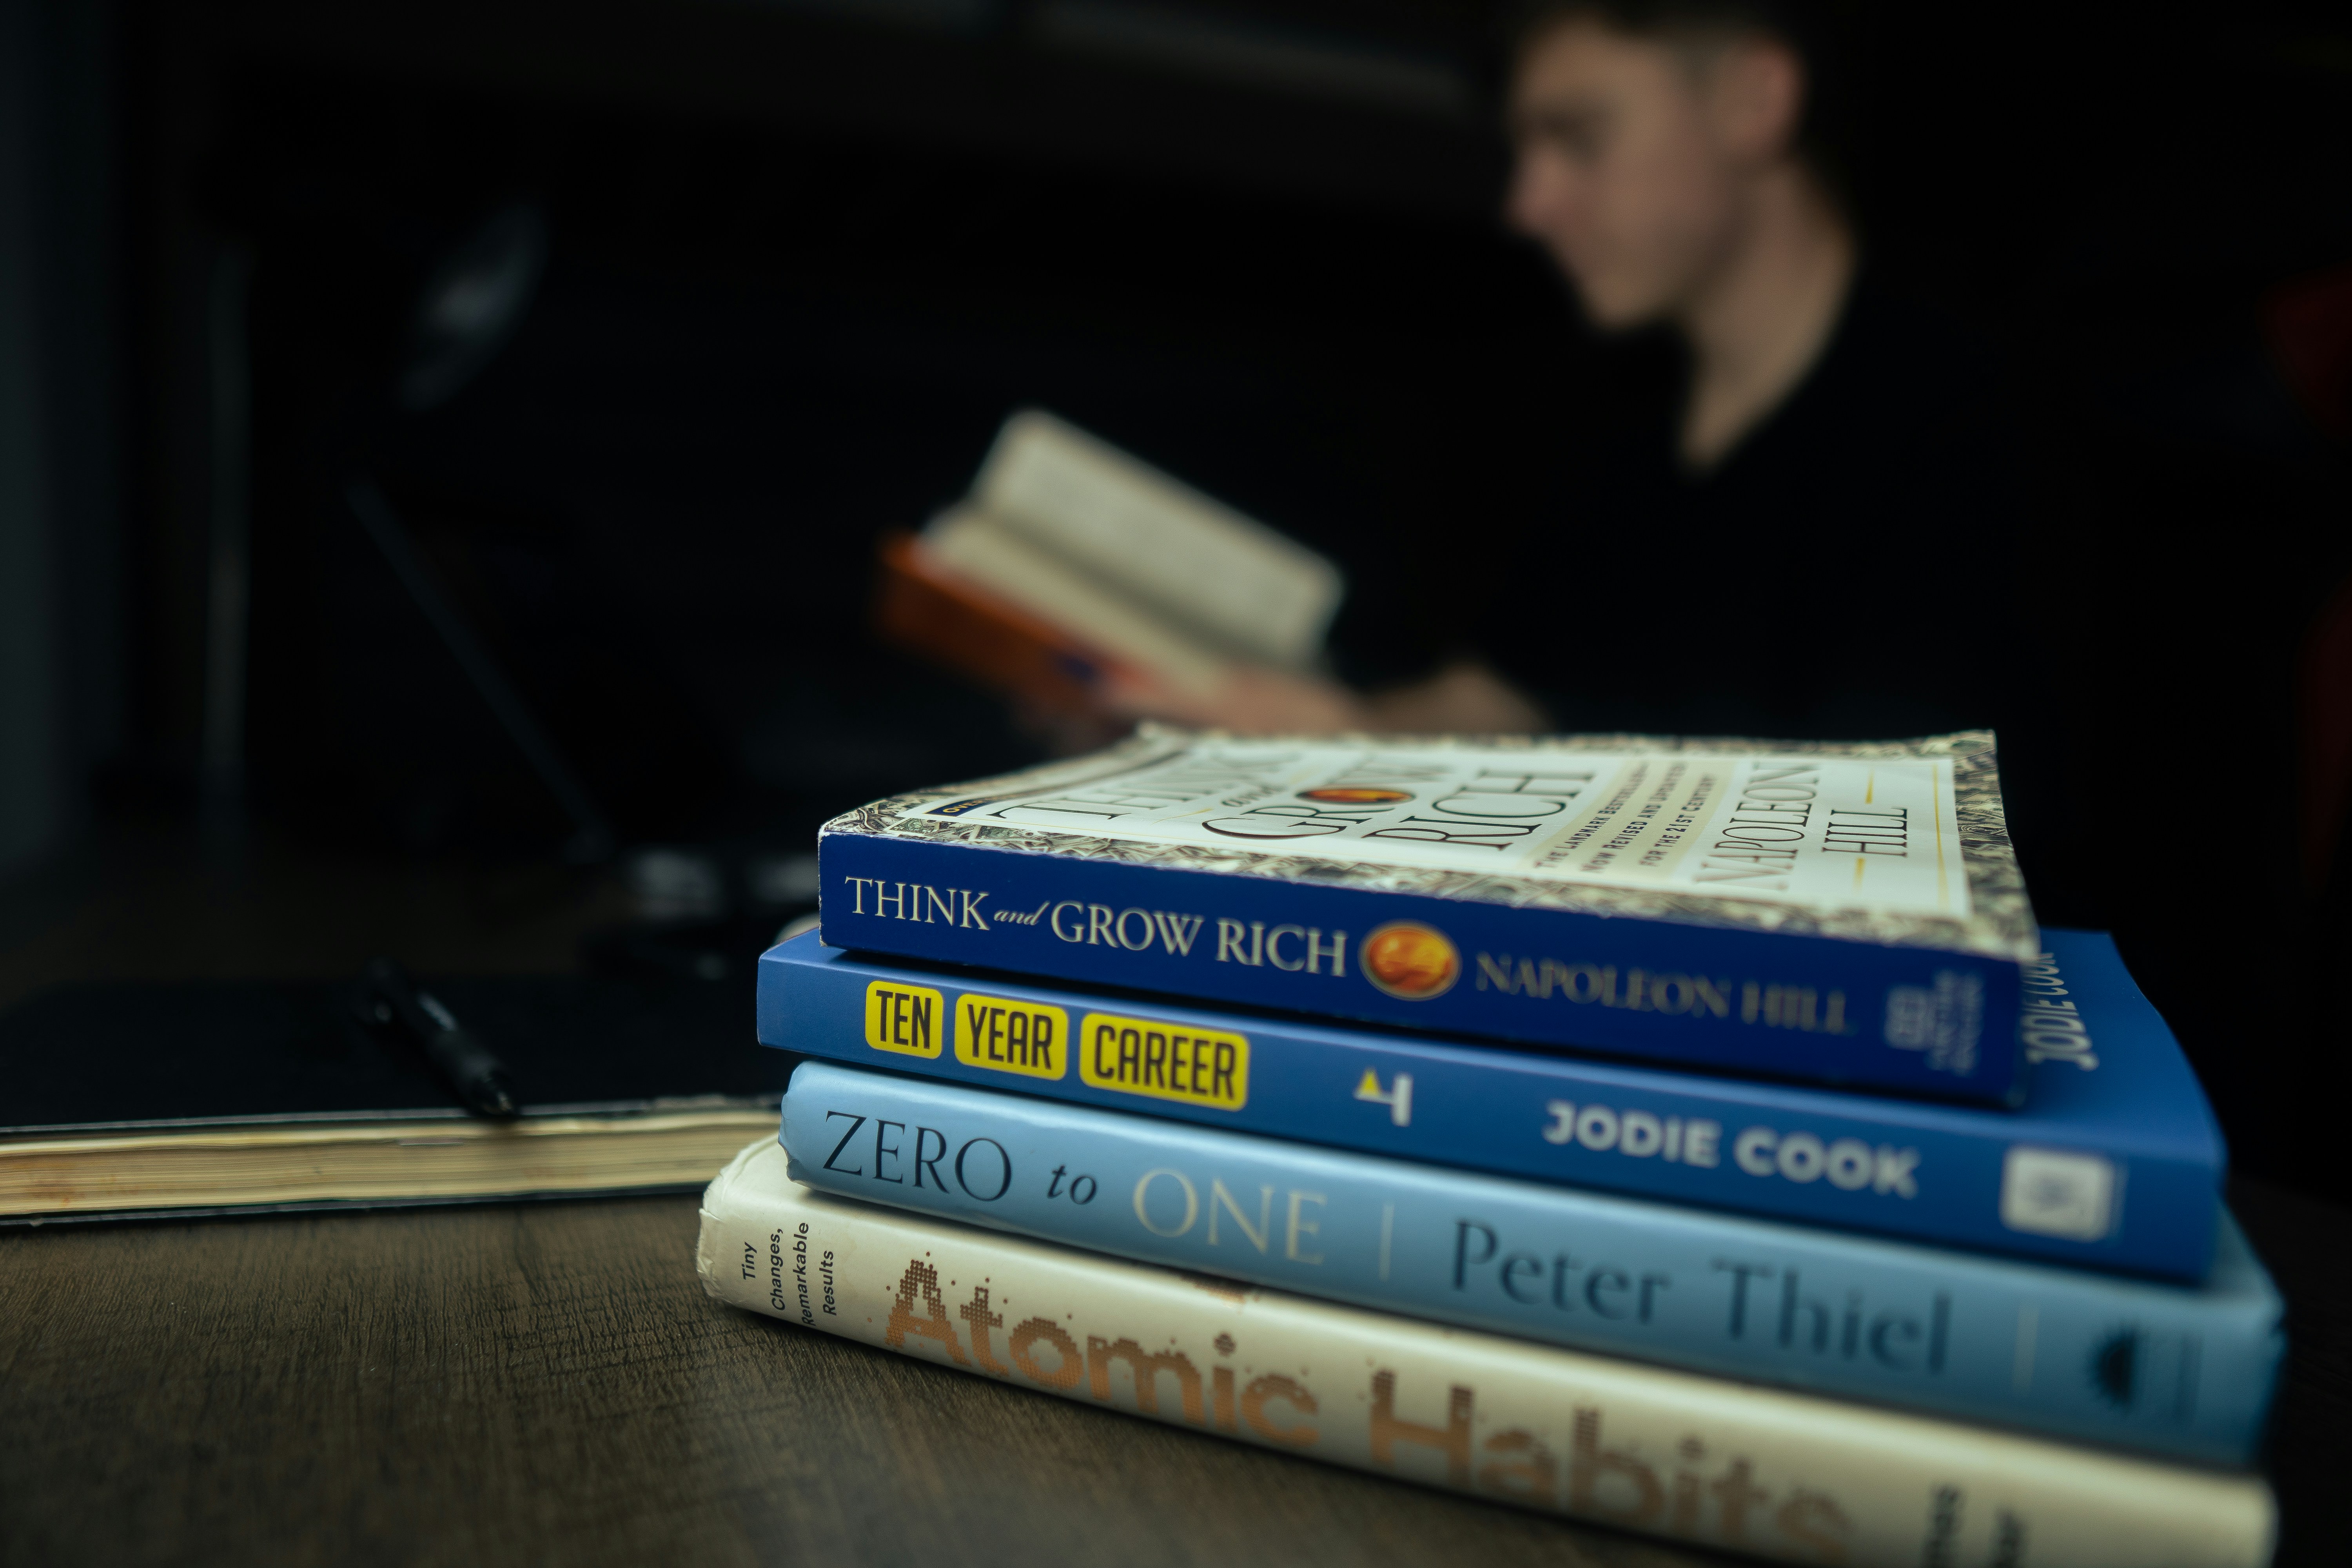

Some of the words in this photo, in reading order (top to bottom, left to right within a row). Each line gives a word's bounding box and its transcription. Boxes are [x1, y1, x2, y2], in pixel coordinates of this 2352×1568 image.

[1361, 768, 1594, 851] RICH
[1533, 850, 1569, 869] THE
[1555, 817, 1610, 849] LANDMARK
[1602, 821, 1648, 849] REVISED
[1637, 805, 1661, 818] AND
[1654, 835, 1681, 847] THE
[1665, 814, 1695, 833] 21ST
[1694, 762, 1820, 890] NAPOLEON
[1822, 807, 1907, 857] HILL
[1639, 850, 1667, 867] FOR
[845, 876, 989, 931] THINK
[994, 901, 1050, 926] and
[1051, 901, 1204, 957] GROW
[1216, 918, 1347, 978] RICH
[1476, 951, 1730, 1018] NAPOLEON
[1740, 980, 1854, 1035] HILL
[876, 989, 931, 1049] TEN
[967, 1003, 1052, 1070] YEAR
[1094, 1024, 1236, 1104] CAREER
[2021, 1000, 2099, 1071] JODIE
[823, 1111, 1012, 1201] ZERO
[1046, 1165, 1096, 1205] to
[1133, 1169, 1327, 1265] ONE
[1543, 1100, 1721, 1169] JODIE
[1734, 1126, 1920, 1199] COOK
[741, 1242, 757, 1280] Tiny
[770, 1229, 786, 1310] Changes,
[793, 1223, 816, 1326] Remarkable
[819, 1250, 837, 1316] Results
[1451, 1220, 1671, 1323] Peter
[1710, 1256, 1951, 1373] Thiel
[886, 1259, 1319, 1446] Atomic
[1368, 1368, 1850, 1564] Habits
